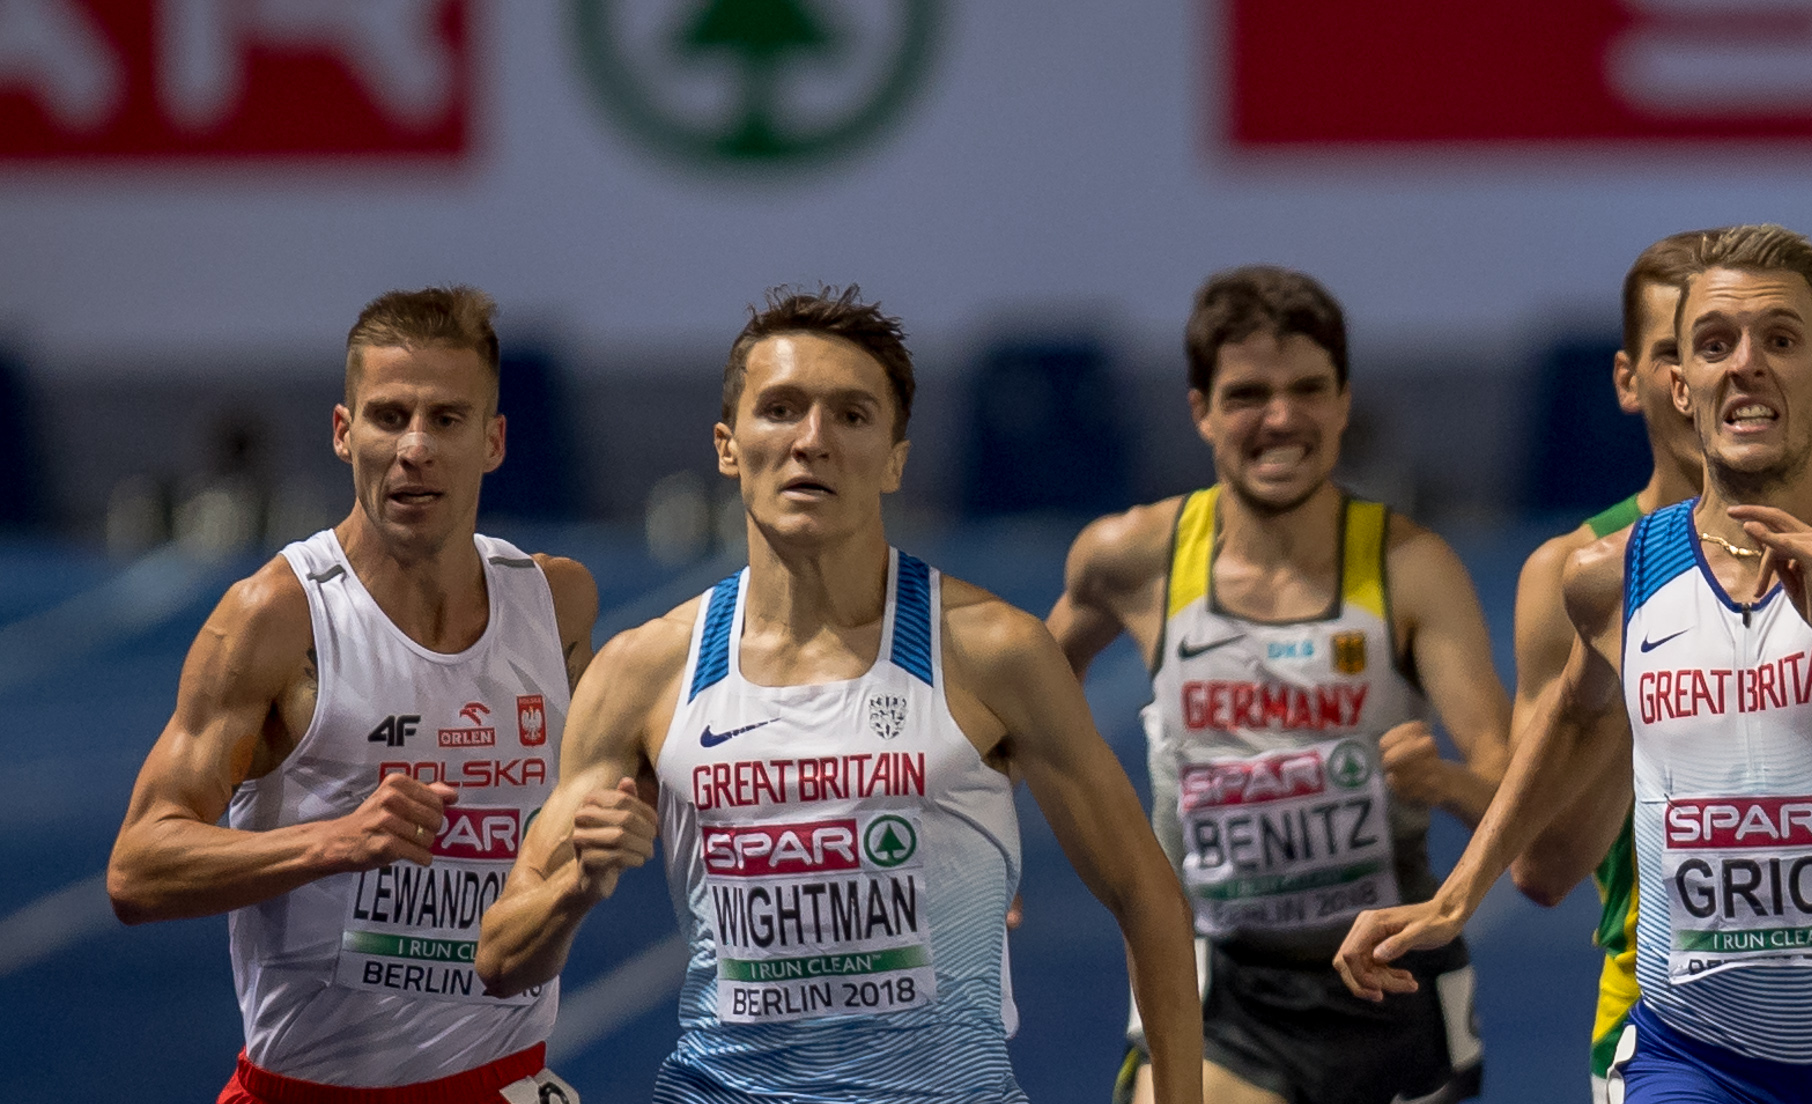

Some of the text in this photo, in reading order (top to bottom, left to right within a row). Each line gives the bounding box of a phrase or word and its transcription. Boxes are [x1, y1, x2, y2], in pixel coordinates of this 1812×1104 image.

[1181, 680, 1369, 732] GERMANY
[1640, 669, 1732, 724] GREAT
[367, 715, 421, 746] 4F
[440, 730, 493, 745] ORLEN
[692, 753, 926, 811] GREAT BRITAIN
[706, 825, 857, 870] SPAR
[1193, 798, 1378, 869] BENITZ
[353, 864, 507, 930] LEWANDO
[712, 875, 918, 948] WIGHTMAN
[398, 941, 404, 955] I
[409, 939, 451, 959] RUN
[1713, 934, 1718, 949] I
[1723, 933, 1765, 949] RUN
[363, 960, 474, 996] BERLIN
[751, 960, 756, 980] I
[760, 958, 803, 979] RUN
[733, 976, 916, 1017] BERLIN 2018
